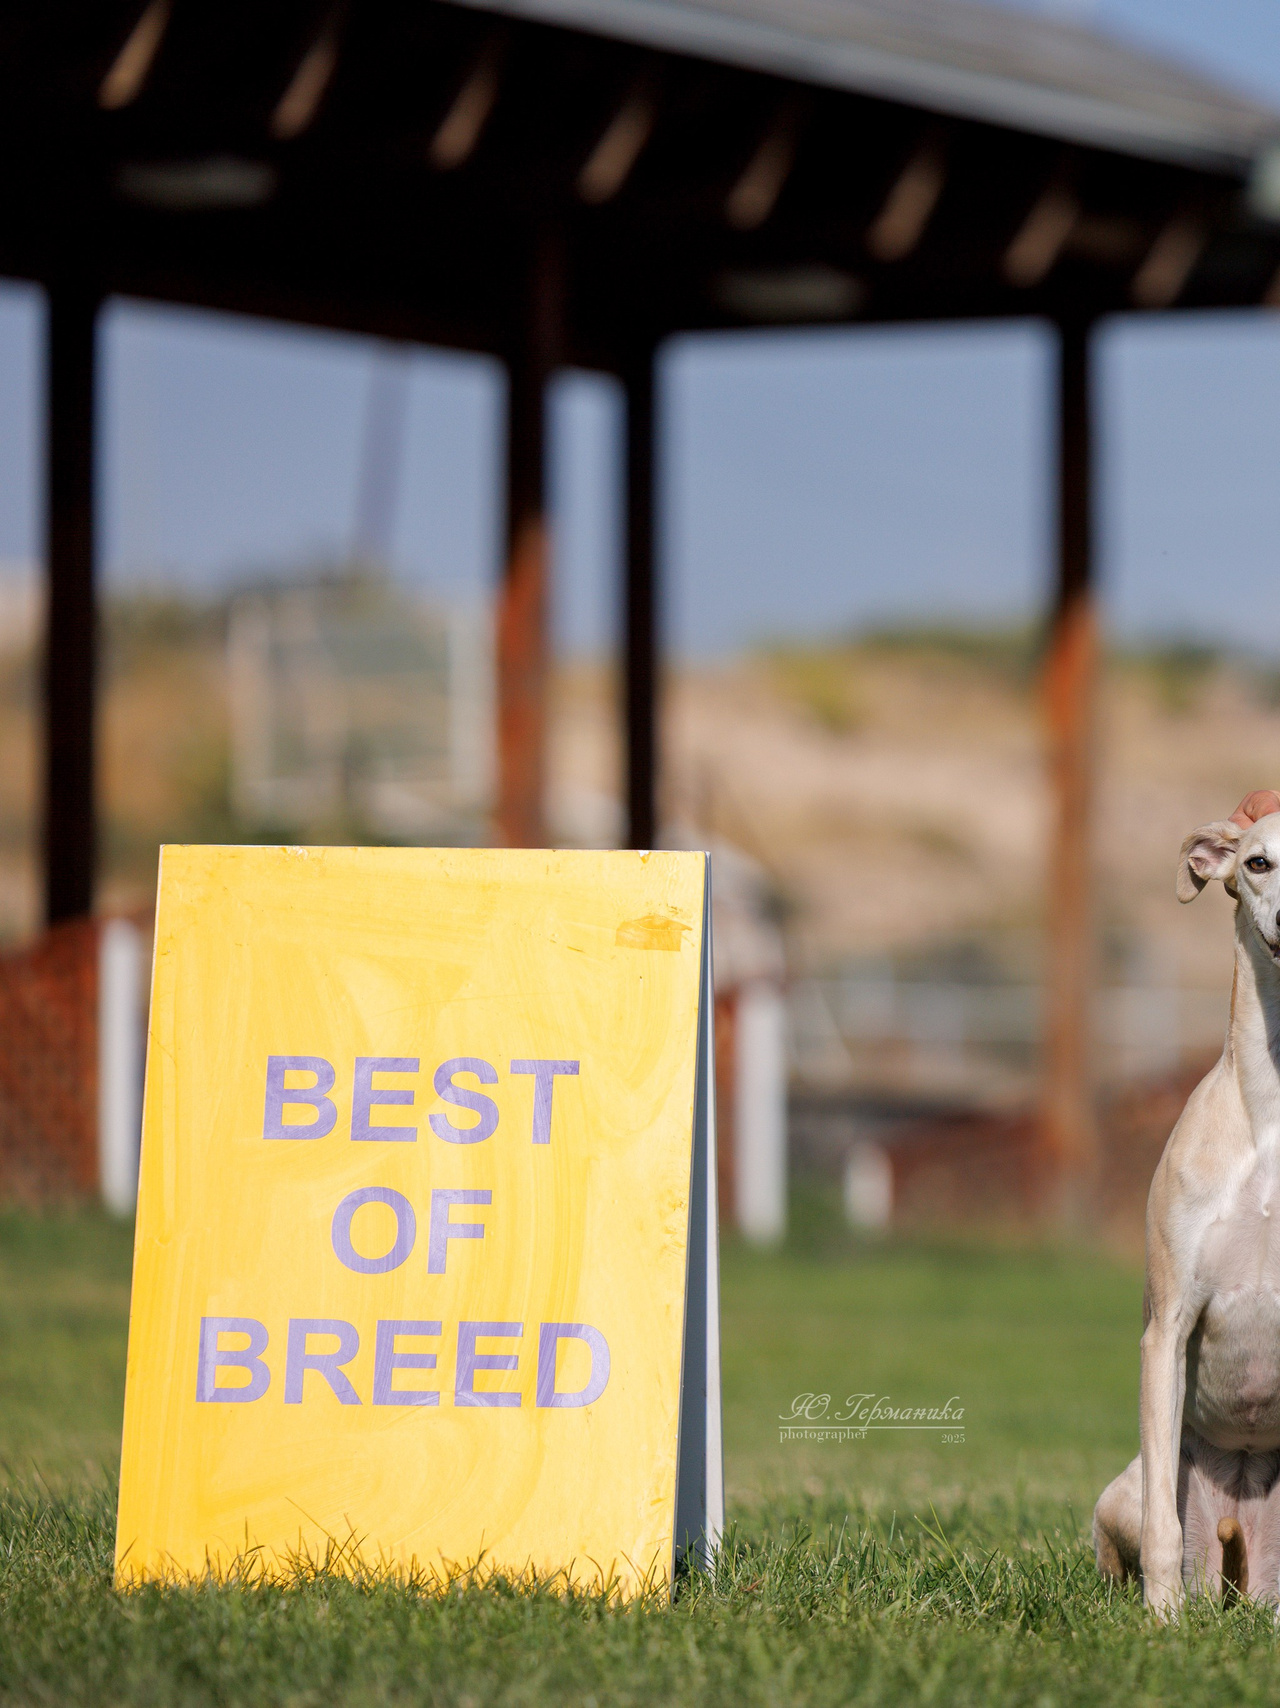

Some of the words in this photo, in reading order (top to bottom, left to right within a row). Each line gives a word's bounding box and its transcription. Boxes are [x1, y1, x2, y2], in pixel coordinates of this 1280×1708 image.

[262, 1055, 581, 1145] BEST
[331, 1186, 493, 1275] OF
[195, 1317, 611, 1408] BREED
